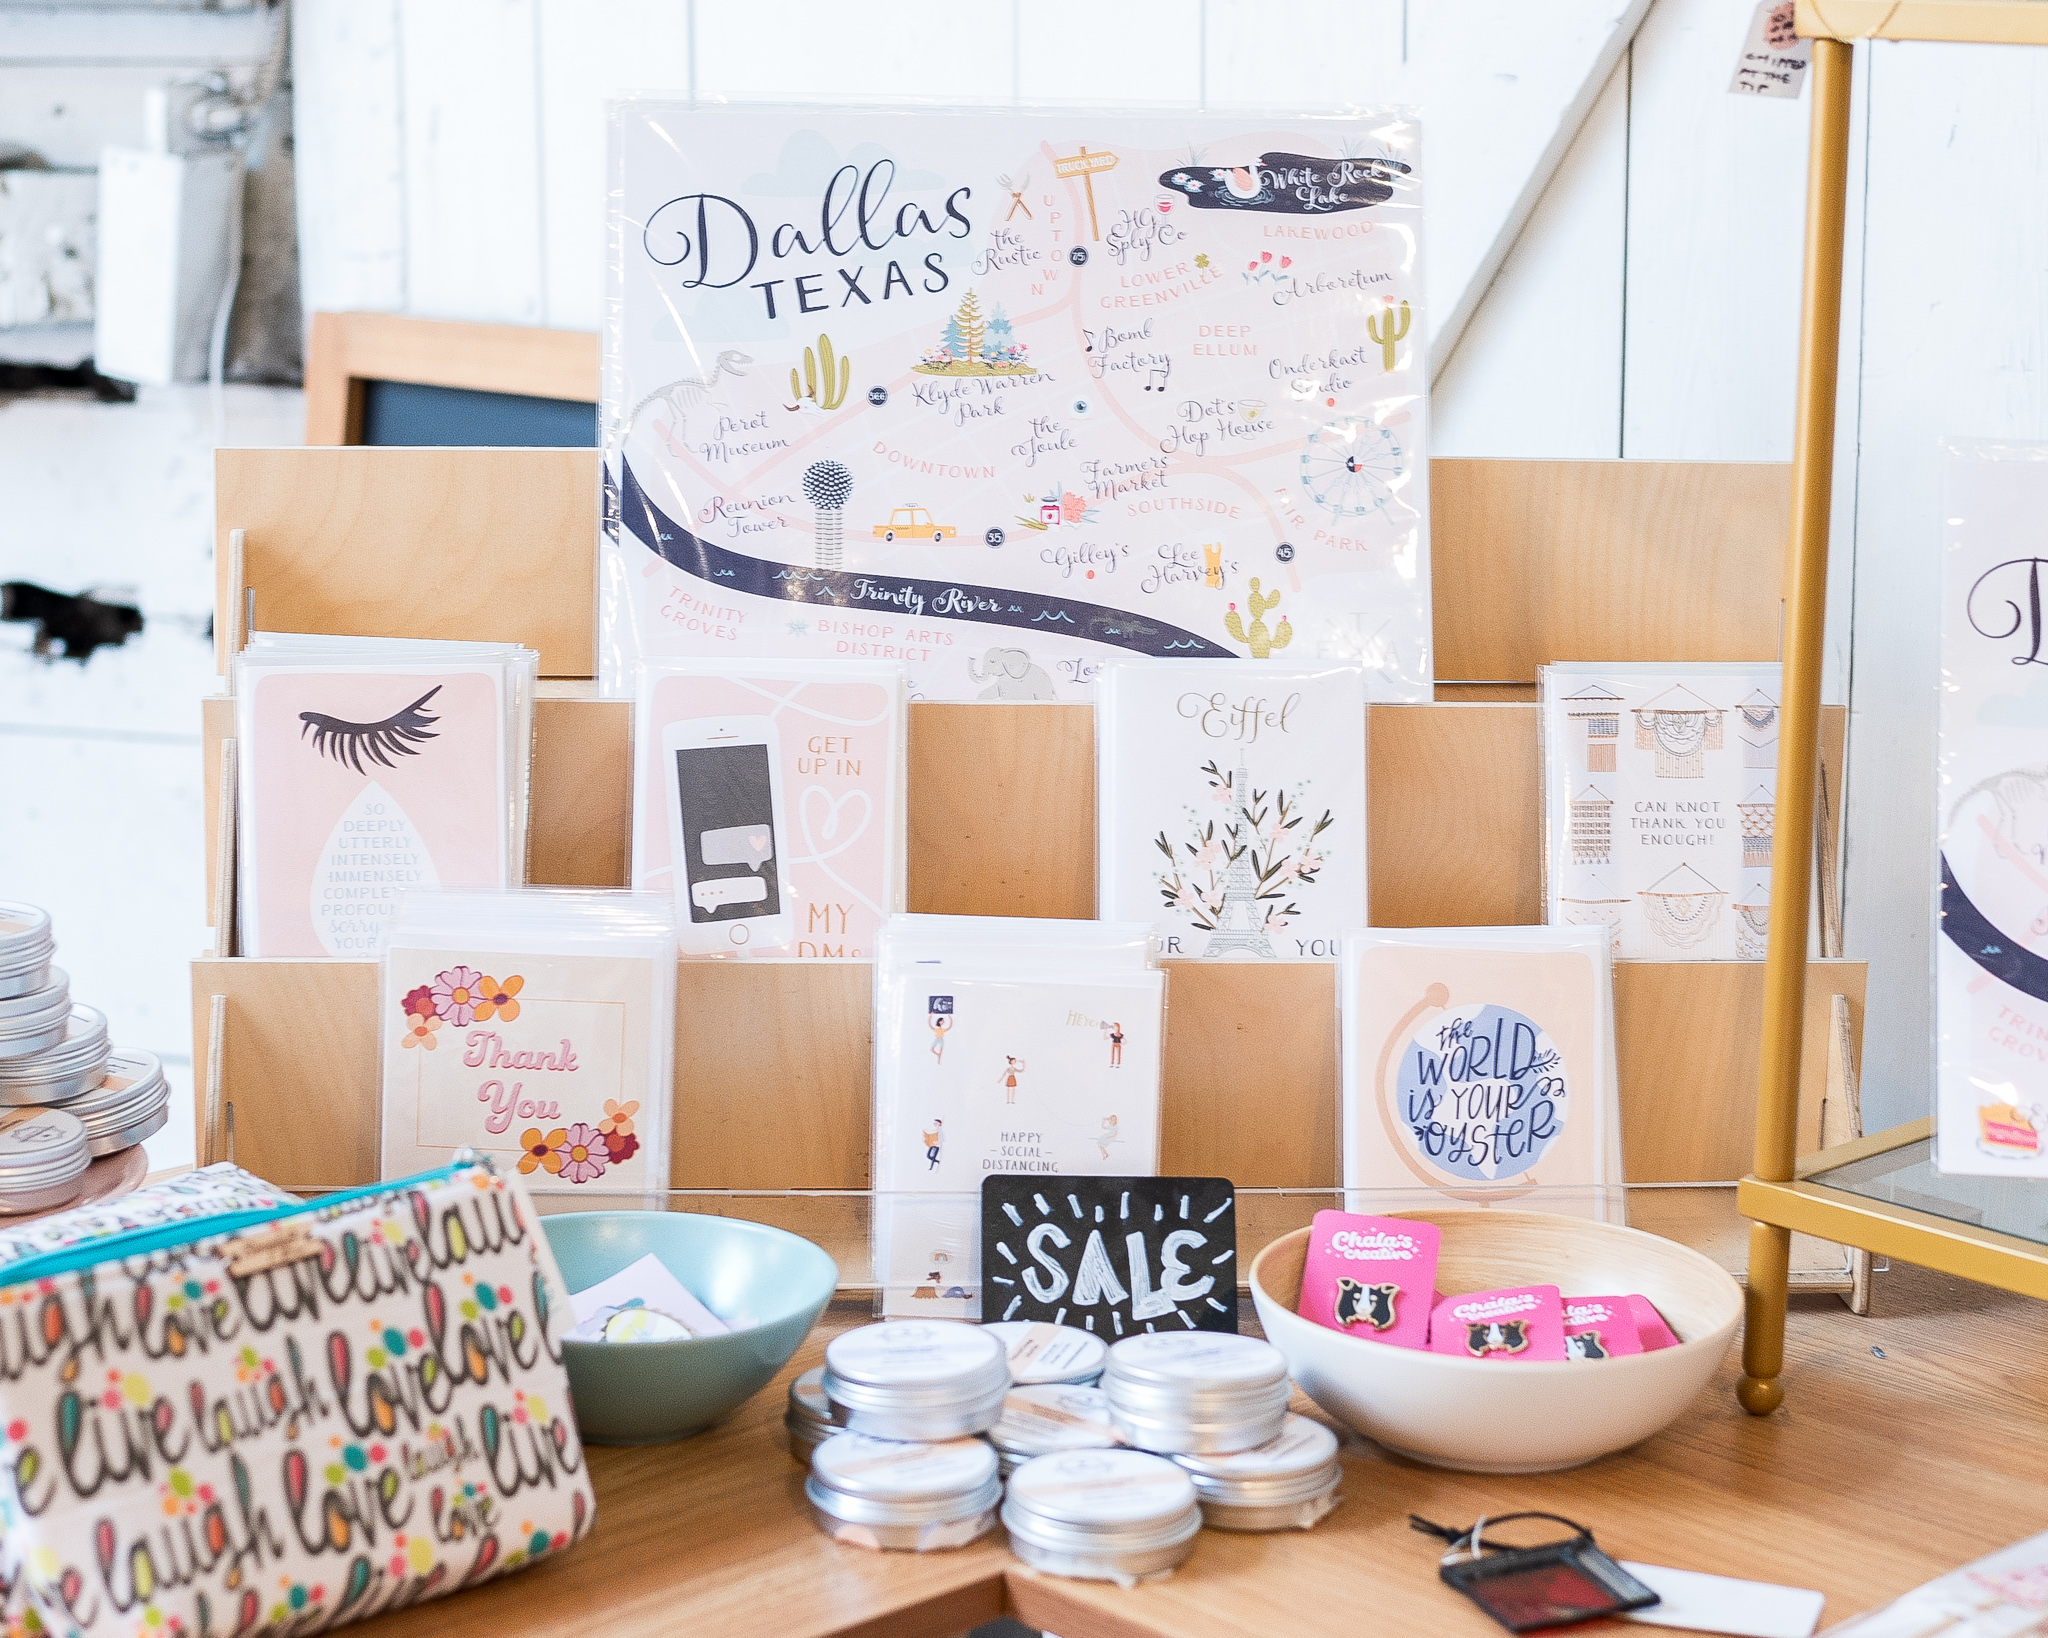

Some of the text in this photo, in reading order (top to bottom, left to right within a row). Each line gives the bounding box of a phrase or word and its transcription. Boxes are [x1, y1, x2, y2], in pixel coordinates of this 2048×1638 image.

[1259, 160, 1384, 190] White Rock
[1296, 186, 1350, 211] Lake
[644, 159, 971, 288] Dallas
[1263, 221, 1376, 240] LAKEWOOD
[990, 228, 1024, 250] the
[1031, 195, 1063, 296] UPTOWN
[971, 248, 1043, 276] Rustic
[1072, 250, 1087, 263] 75
[750, 253, 949, 319] TEXAS
[1100, 266, 1224, 309] GREENVILLE
[1120, 262, 1190, 288] LOWER
[1273, 269, 1395, 305] Arboretum
[1098, 318, 1153, 353] Bomb
[1198, 325, 1252, 338] DEEP
[1193, 343, 1257, 356] ELLUM
[1088, 352, 1172, 379] Factory
[972, 372, 1056, 396] Warren
[953, 396, 1006, 427] Park
[1176, 398, 1236, 423] Dot's
[713, 411, 770, 441] Perot
[1027, 415, 1064, 438] the
[699, 437, 791, 463] Museum
[872, 441, 996, 479] DOWNTOWN
[1011, 429, 1080, 467] Joule
[1080, 456, 1170, 481] Farmers
[1083, 470, 1170, 501] Market
[697, 493, 798, 524] Reunion
[1127, 497, 1241, 520] SOUTHSIDE
[726, 515, 790, 537] Tower
[987, 532, 1002, 543] 35
[1277, 548, 1293, 558] 45
[1313, 529, 1368, 551] PARK
[1040, 542, 1130, 578] Gilley's
[1157, 543, 1200, 568] Lee
[1141, 559, 1240, 593] Harvey's
[667, 585, 748, 624] TRINITY
[850, 578, 1003, 615] Trinity River
[660, 604, 739, 640] GROVES
[818, 619, 954, 646] BISHOP ARTS
[836, 640, 932, 661] DISTRICT
[1177, 692, 1302, 743] Eiffel
[808, 736, 853, 753] GET
[798, 757, 862, 776] UP IN
[364, 803, 385, 816] SO
[1634, 801, 1721, 813] CAN KNOT
[343, 820, 406, 832] DEEPLY
[1630, 817, 1727, 829] THANK YOU
[338, 836, 412, 849] UTTERLY
[1640, 833, 1716, 846] ENOUGH!
[331, 853, 419, 866] INTENSELY
[328, 869, 423, 883] IMMENSELY
[808, 902, 854, 934] MY
[335, 937, 377, 949] YOUR
[1436, 1017, 1474, 1051] the
[463, 1030, 579, 1072] Thank
[1417, 1017, 1538, 1086] WORLD
[477, 1080, 561, 1134] You
[1451, 1082, 1540, 1121] YOUR
[1001, 1132, 1043, 1144] HAPPY
[982, 1159, 1059, 1174] DISTANCING
[1331, 1230, 1414, 1253] Chala's
[1343, 1247, 1414, 1261] creative
[1022, 1223, 1216, 1321] SALE
[1453, 1293, 1535, 1319] Chala's
[134, 1283, 243, 1360] love
[57, 1389, 192, 1498] live
[188, 1334, 331, 1454] laugh
[325, 1329, 453, 1439] love
[423, 1281, 540, 1386] love
[95, 1452, 284, 1614] laugh
[282, 1449, 415, 1556] love
[479, 1403, 583, 1498] live
